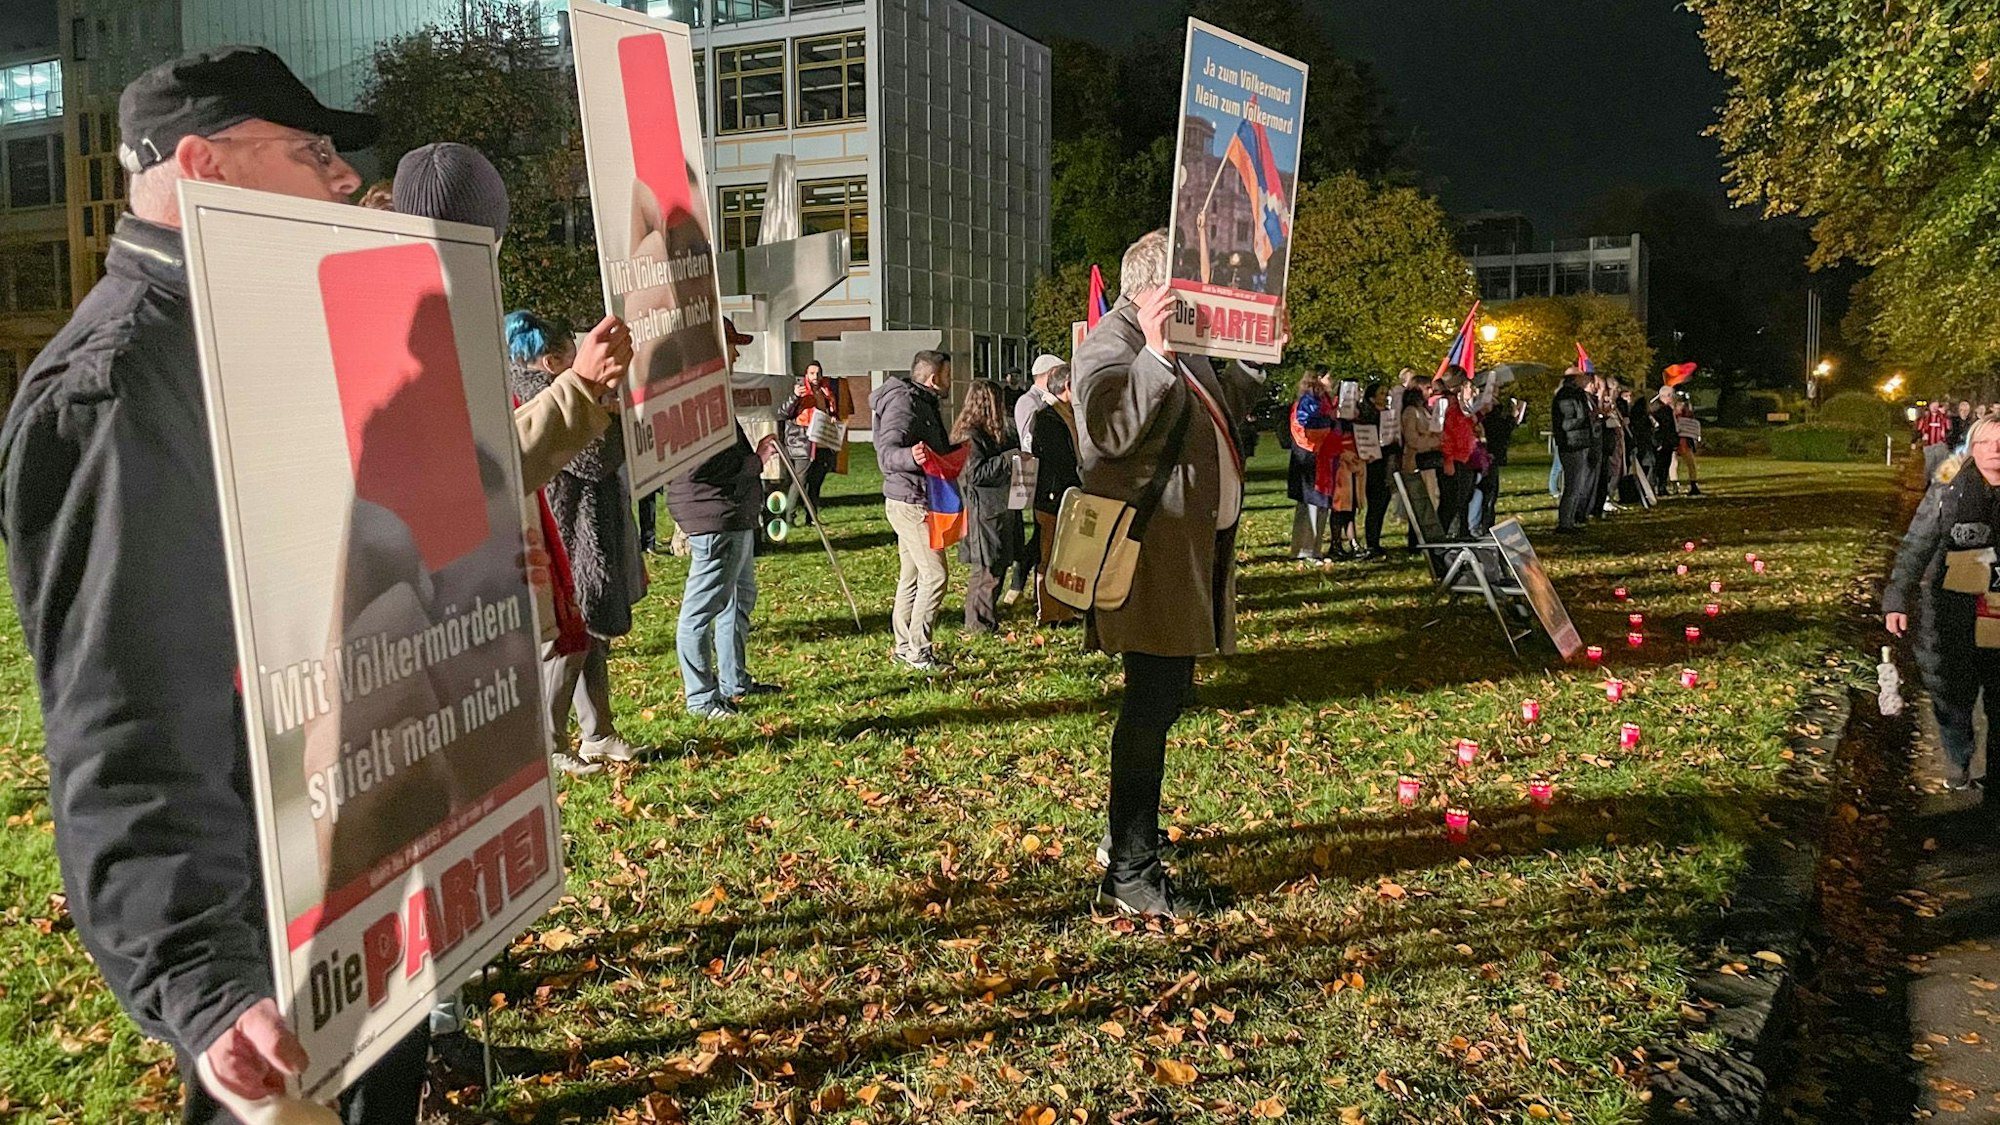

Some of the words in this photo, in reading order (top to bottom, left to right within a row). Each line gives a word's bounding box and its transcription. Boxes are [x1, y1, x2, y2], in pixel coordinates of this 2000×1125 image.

[1203, 56, 1216, 77] Ja
[1218, 65, 1238, 85] zum
[1241, 69, 1291, 105] Völkermord
[1195, 84, 1218, 109] Nein
[1221, 97, 1240, 116] zum
[1243, 100, 1293, 134] Völkermord
[610, 260, 633, 295] Mit
[633, 248, 711, 289] Völkermördern
[661, 307, 685, 335] man
[686, 295, 711, 327] nicht
[1176, 300, 1195, 325] Die
[1196, 304, 1276, 346] PARTEI
[634, 417, 654, 456] Die
[652, 384, 729, 462] PARTEI
[269, 659, 330, 735] Mit
[334, 594, 521, 704] Völkermördern
[308, 729, 396, 823] spielt
[402, 705, 457, 766] man
[461, 666, 521, 734] nicht
[310, 948, 362, 1032] Die
[363, 806, 549, 1011] PARTEI
